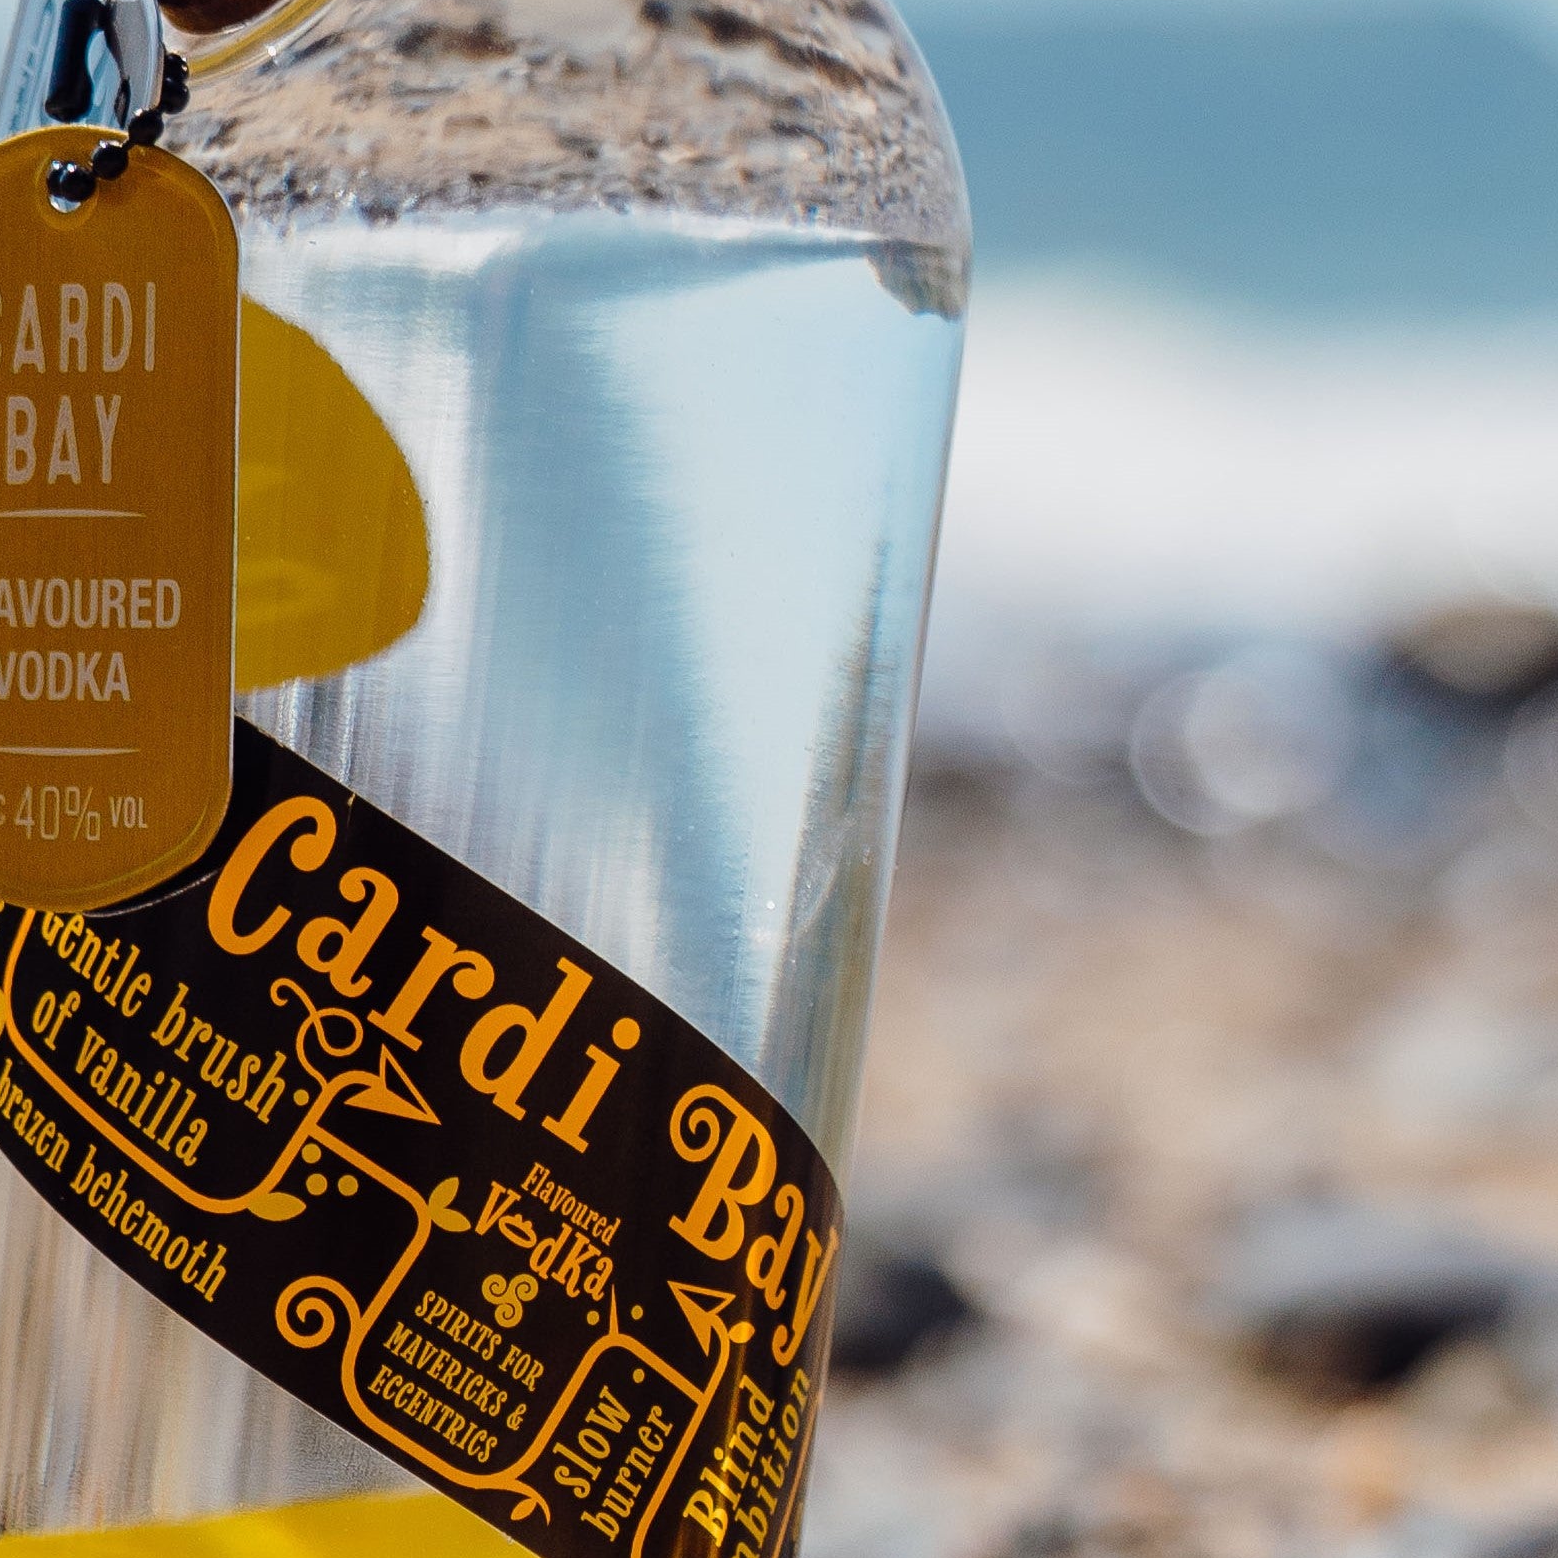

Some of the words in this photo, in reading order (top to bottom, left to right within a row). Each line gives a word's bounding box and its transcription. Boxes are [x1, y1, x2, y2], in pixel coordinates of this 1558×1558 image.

[5, 395, 121, 486] BAY
[14, 785, 100, 842] 40%
[109, 795, 147, 830] VOL
[41, 910, 154, 1019] Gentle
[156, 982, 289, 1124] brush
[32, 990, 82, 1051] of
[75, 1024, 210, 1169] vanilla
[207, 795, 642, 1155] Cardi
[668, 1082, 841, 1369] Bay
[69, 1143, 229, 1305] behemoth
[521, 1161, 622, 1247] Flavoured
[382, 1321, 509, 1419] MAVERICKS
[506, 1402, 528, 1432] &
[414, 1290, 502, 1362] SPIRITS
[498, 1343, 545, 1392] FOR
[367, 1364, 499, 1464] ECCENTRICS
[552, 1384, 633, 1500] slow
[682, 1374, 776, 1549] Blind
[580, 1404, 675, 1543] burner
